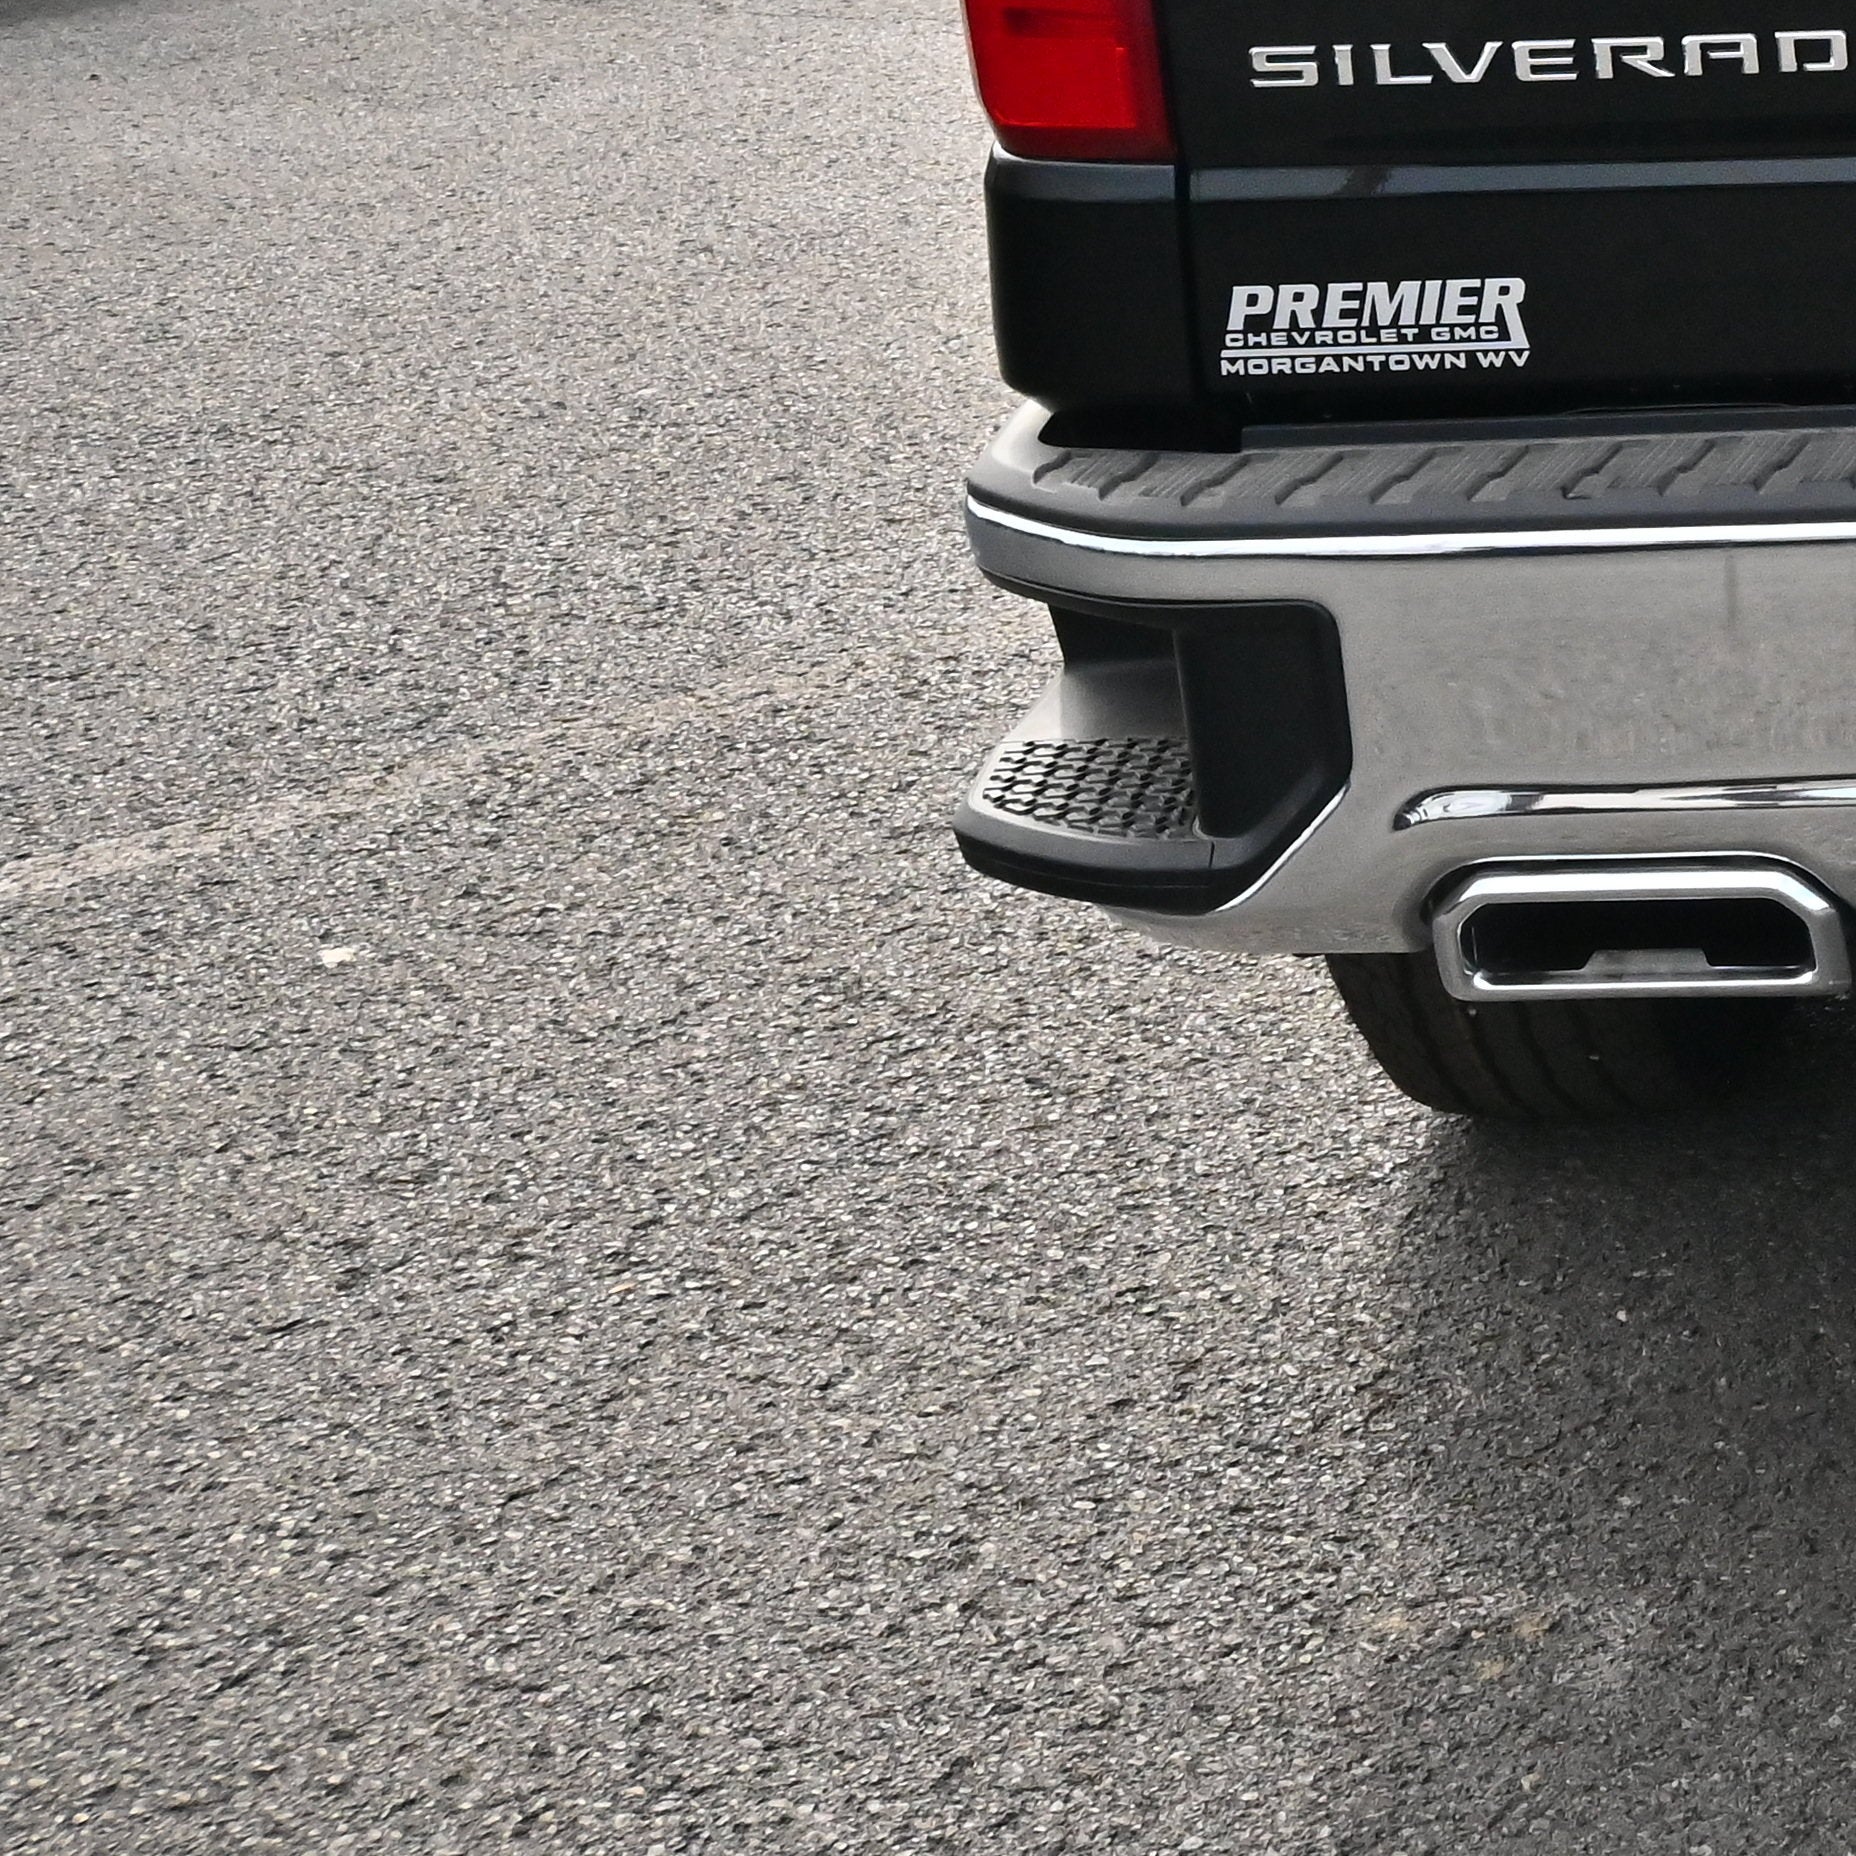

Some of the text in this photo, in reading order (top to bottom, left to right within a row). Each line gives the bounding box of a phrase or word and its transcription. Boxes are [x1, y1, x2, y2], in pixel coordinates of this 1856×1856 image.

[1226, 277, 1530, 347] PREMIER
[1224, 325, 1499, 347] CHEVROLET GMC
[1220, 350, 1530, 376] MORGANTOWN WV
